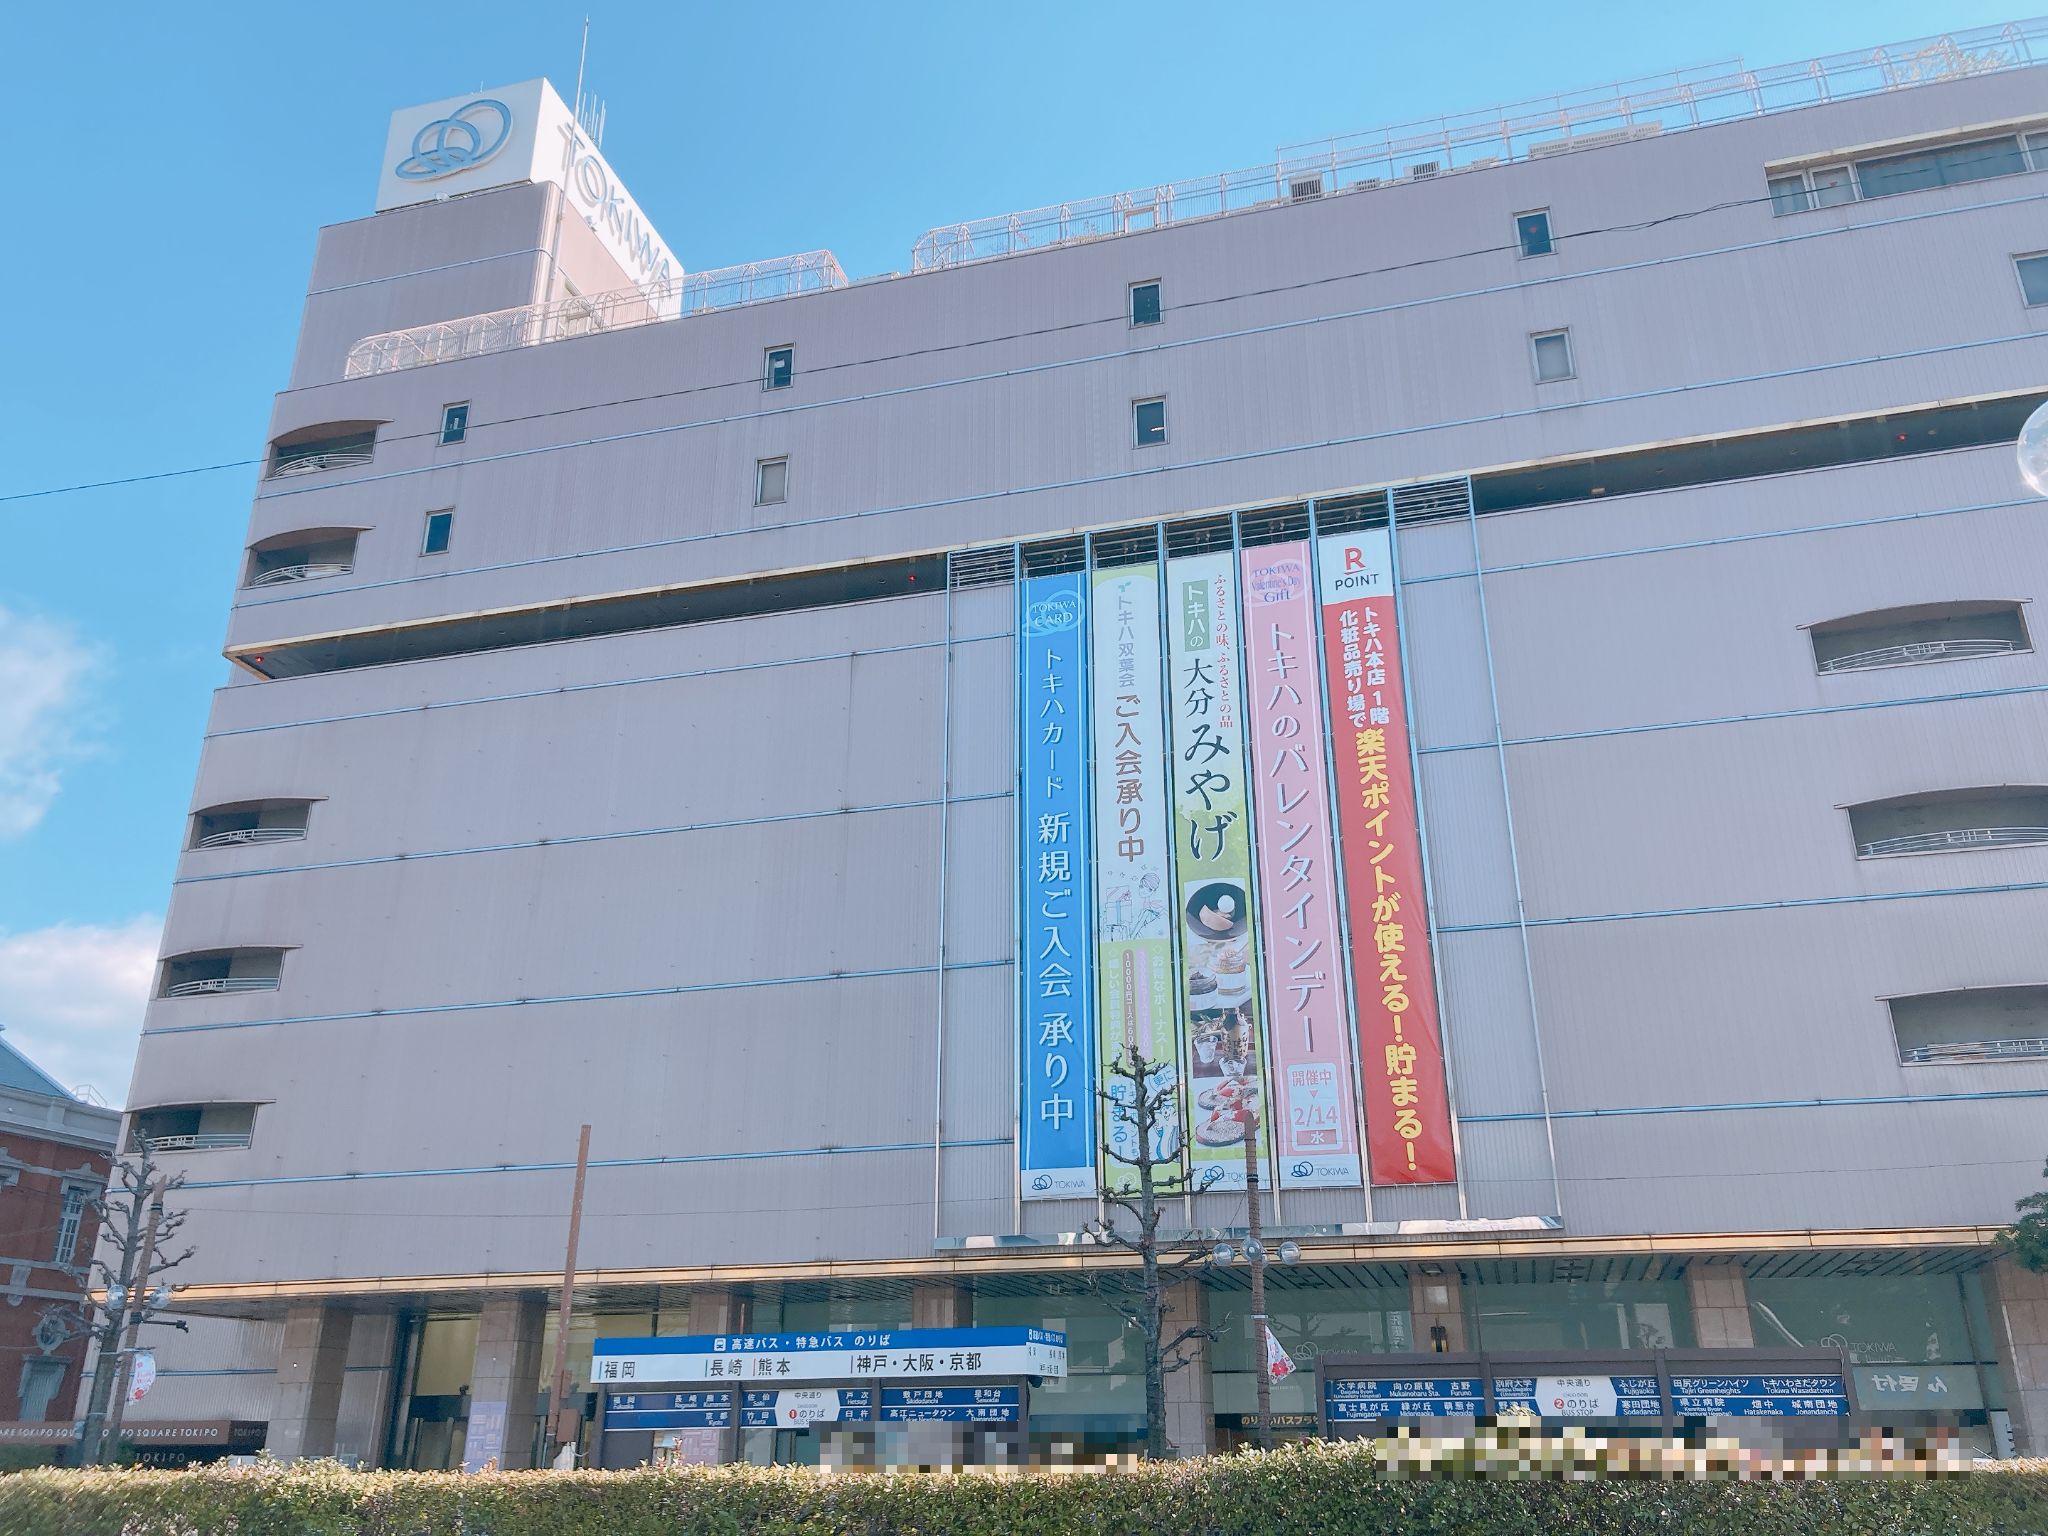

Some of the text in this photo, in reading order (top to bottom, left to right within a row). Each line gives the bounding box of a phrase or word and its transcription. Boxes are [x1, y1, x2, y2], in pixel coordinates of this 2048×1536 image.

[563, 122, 672, 298] TOKIWA
[1252, 563, 1300, 577] TOKIWA
[1335, 574, 1379, 590] POINT
[1264, 588, 1292, 603] Gift
[1031, 600, 1076, 613] TOKIWA
[1035, 612, 1073, 627] CARD
[1187, 585, 1206, 647] トキハの
[1118, 596, 1135, 688] トキハ双葉会
[1363, 607, 1386, 686] トキハ本店
[1339, 609, 1366, 728] 化粧品売り場で
[1040, 649, 1065, 798] トキハカード
[1266, 623, 1325, 1052] トキハのバレンタインデー
[1292, 1069, 1332, 1087] 開催中
[1294, 1104, 1338, 1127] 2/14
[1311, 1131, 1324, 1144] 水
[1226, 1172, 1248, 1181] TOKI
[1317, 1167, 1349, 1176] TOKIWA
[1055, 1180, 1086, 1189] TOKIWA
[854, 1334, 891, 1346] のりば
[605, 1361, 636, 1379] 福岡
[710, 1359, 743, 1377] 長崎
[758, 1358, 791, 1376] 熊本
[1336, 1382, 1377, 1390] 大学病院
[1393, 1382, 1434, 1390] 向の原駅
[1451, 1381, 1471, 1390] 古野
[1556, 1379, 1591, 1387] 中央通り
[1619, 1379, 1657, 1388] ふじが丘
[1673, 1379, 1749, 1388] 田尻グリーンハイツ
[1762, 1379, 1837, 1388] トキハわさだタウン
[795, 1391, 822, 1399] 中央通り
[1338, 1403, 1389, 1412] 富士見が丘
[1401, 1402, 1432, 1411] 緑が丘
[1680, 1397, 1725, 1407] 県立病院
[1792, 1400, 1838, 1409] 城南団地
[800, 1409, 825, 1418] のりば
[890, 1409, 955, 1418] 高江ニュータウン
[966, 1408, 1009, 1417] 大南団地
[136, 1429, 177, 1437] SQUARE
[180, 1429, 218, 1437] TOKIPO
